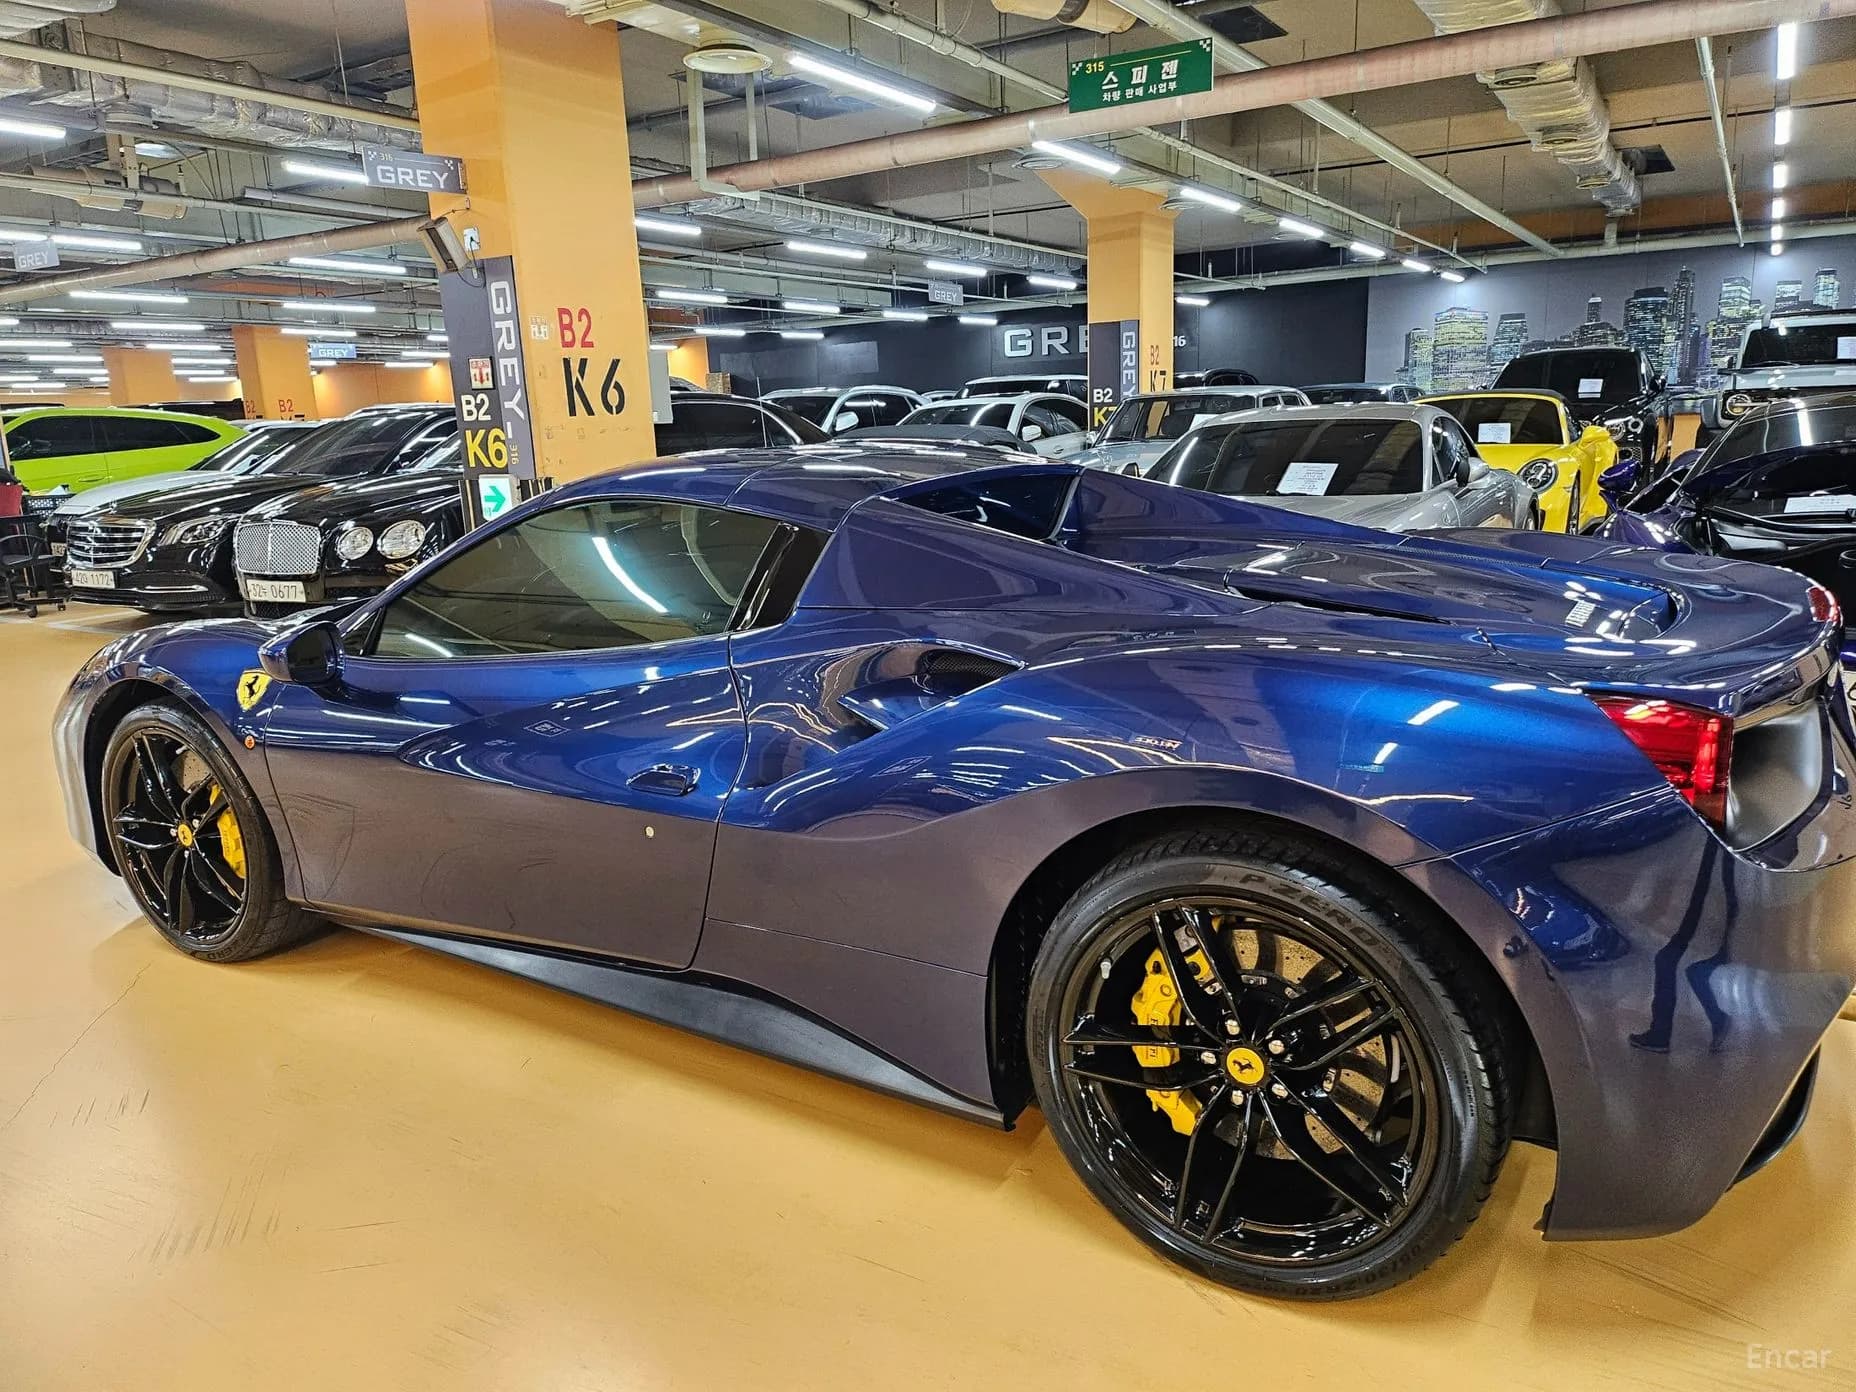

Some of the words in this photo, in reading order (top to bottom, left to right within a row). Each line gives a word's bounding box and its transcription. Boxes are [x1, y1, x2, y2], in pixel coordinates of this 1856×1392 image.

[1085, 61, 1104, 74] 315
[1102, 90, 1121, 102] 차량
[1125, 86, 1144, 99] 판매
[1148, 81, 1177, 94] 사업부
[376, 165, 449, 189] GREY
[18, 251, 49, 269] GREY
[934, 290, 957, 302] GREY
[556, 307, 595, 349] B2
[1003, 325, 1088, 358] GR
[318, 348, 349, 357] GREY
[1150, 345, 1160, 366] B2
[1122, 331, 1136, 397] GREY
[562, 357, 626, 417] K6
[1149, 370, 1167, 393] K7
[1093, 388, 1113, 403] B2
[246, 400, 257, 414] B2
[278, 399, 294, 413] B2
[461, 393, 492, 422] B2
[465, 427, 509, 469] K6
[91, 573, 111, 586] 1172
[270, 584, 298, 599] 0677
[1239, 873, 1267, 884] P
